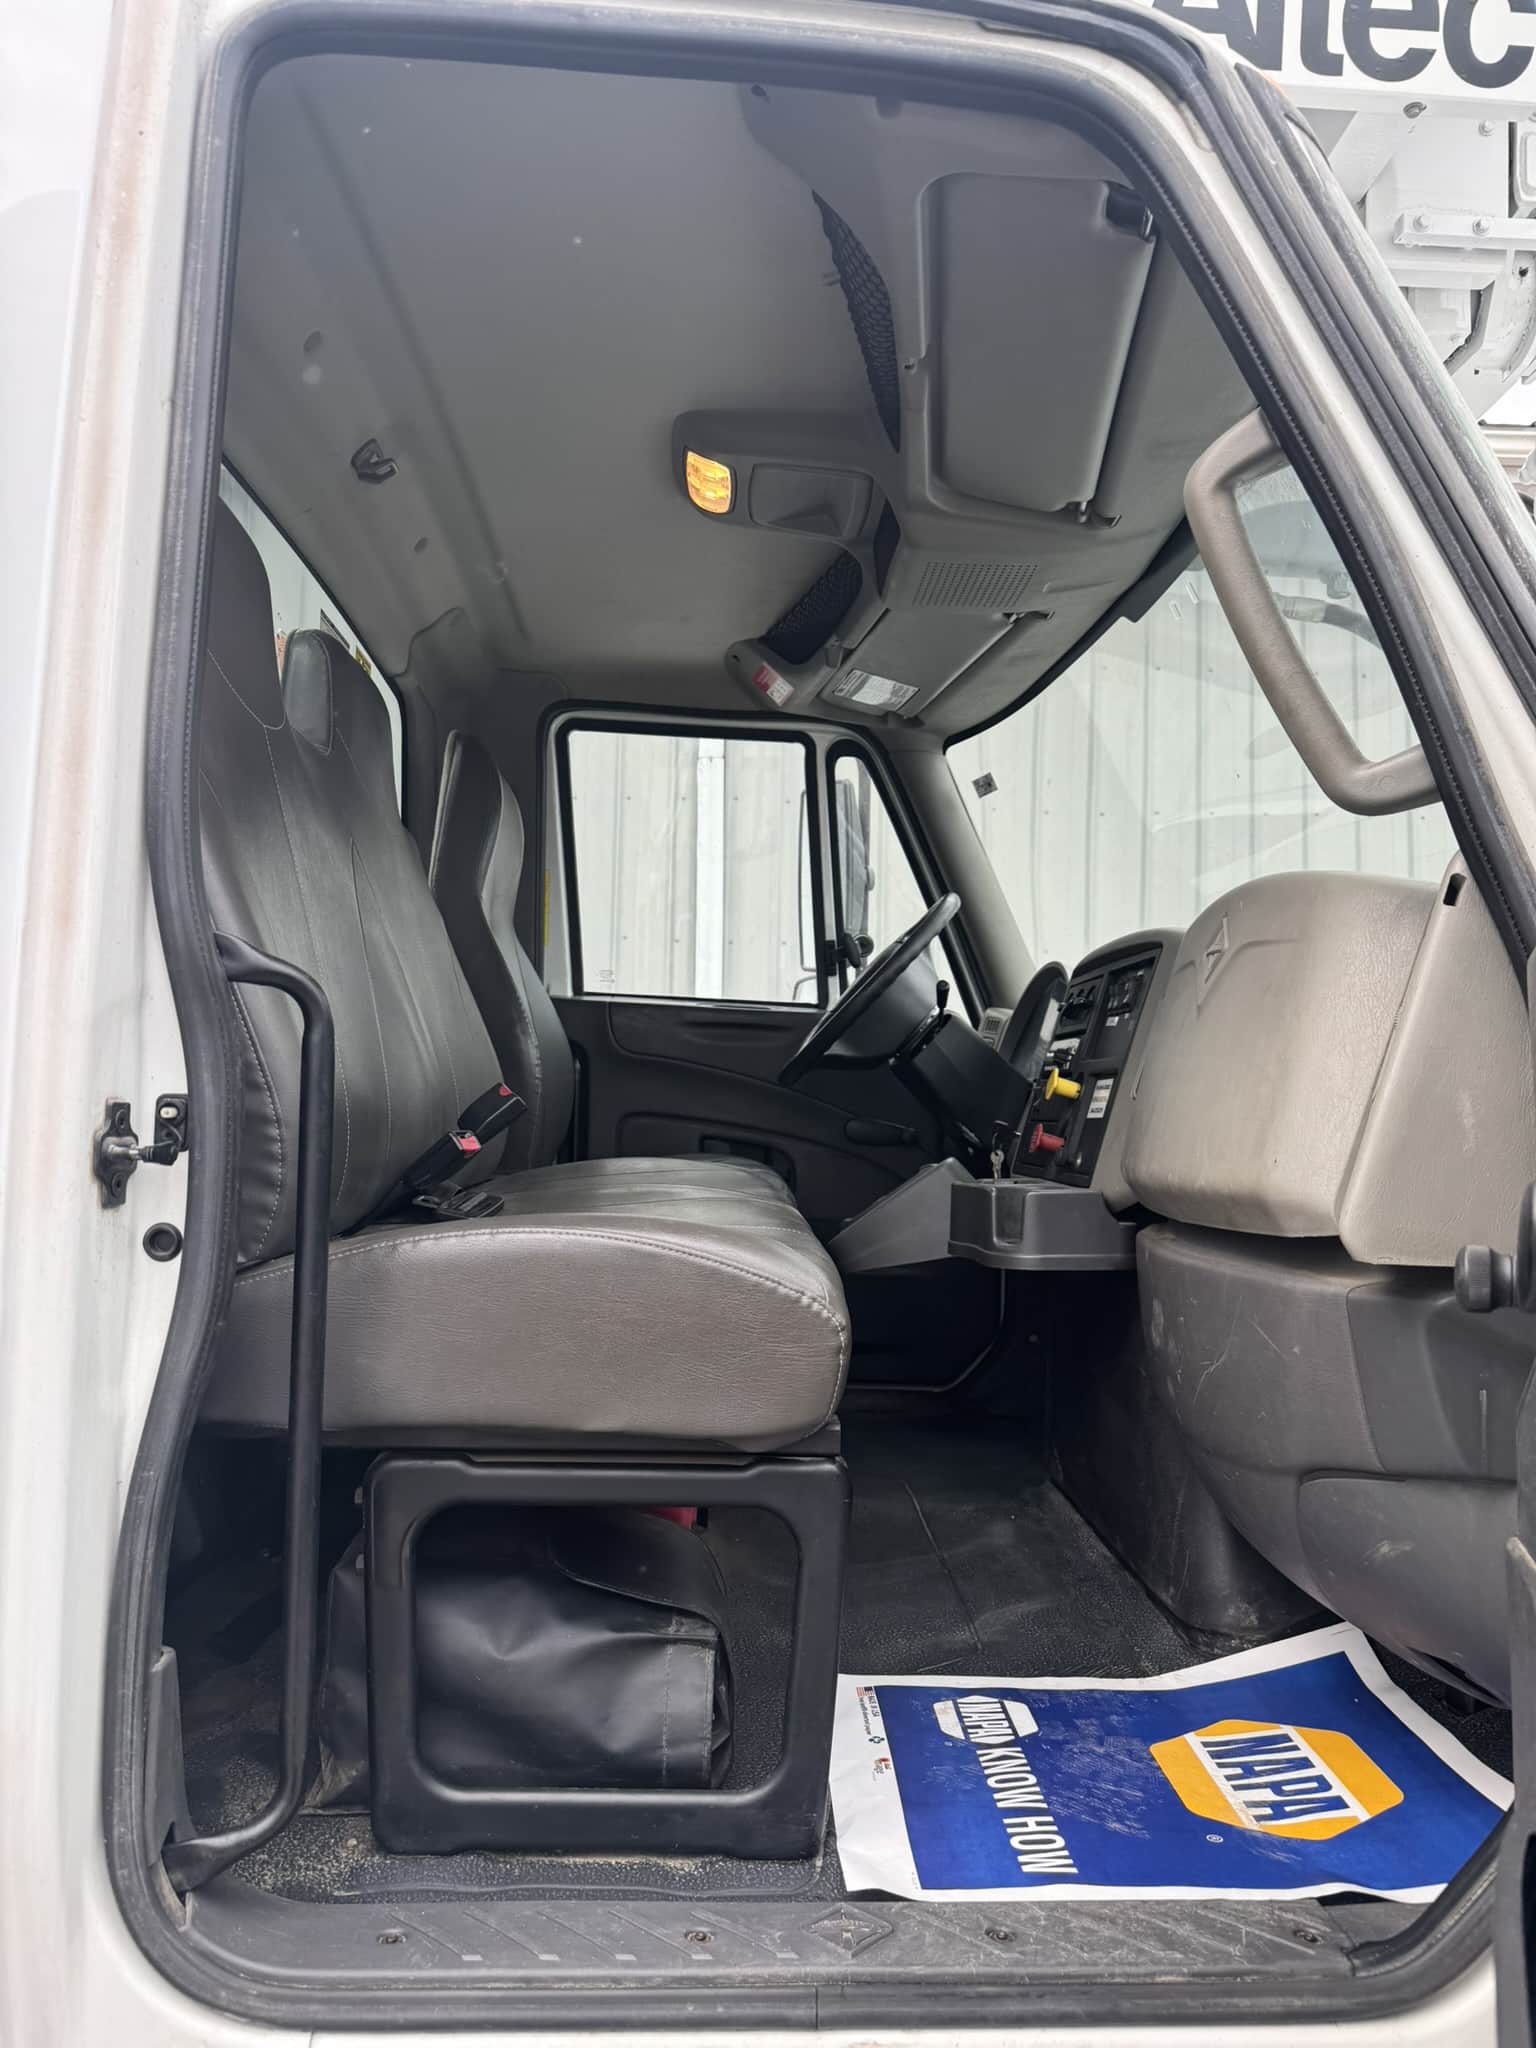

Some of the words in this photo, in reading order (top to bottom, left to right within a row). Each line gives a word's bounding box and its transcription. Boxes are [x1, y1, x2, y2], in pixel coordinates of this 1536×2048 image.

[958, 1703, 1015, 1740] NAPA
[976, 1747, 1049, 1808] KNOW
[1200, 1733, 1351, 1823] NAPA
[1002, 1815, 1079, 1873] HOW
